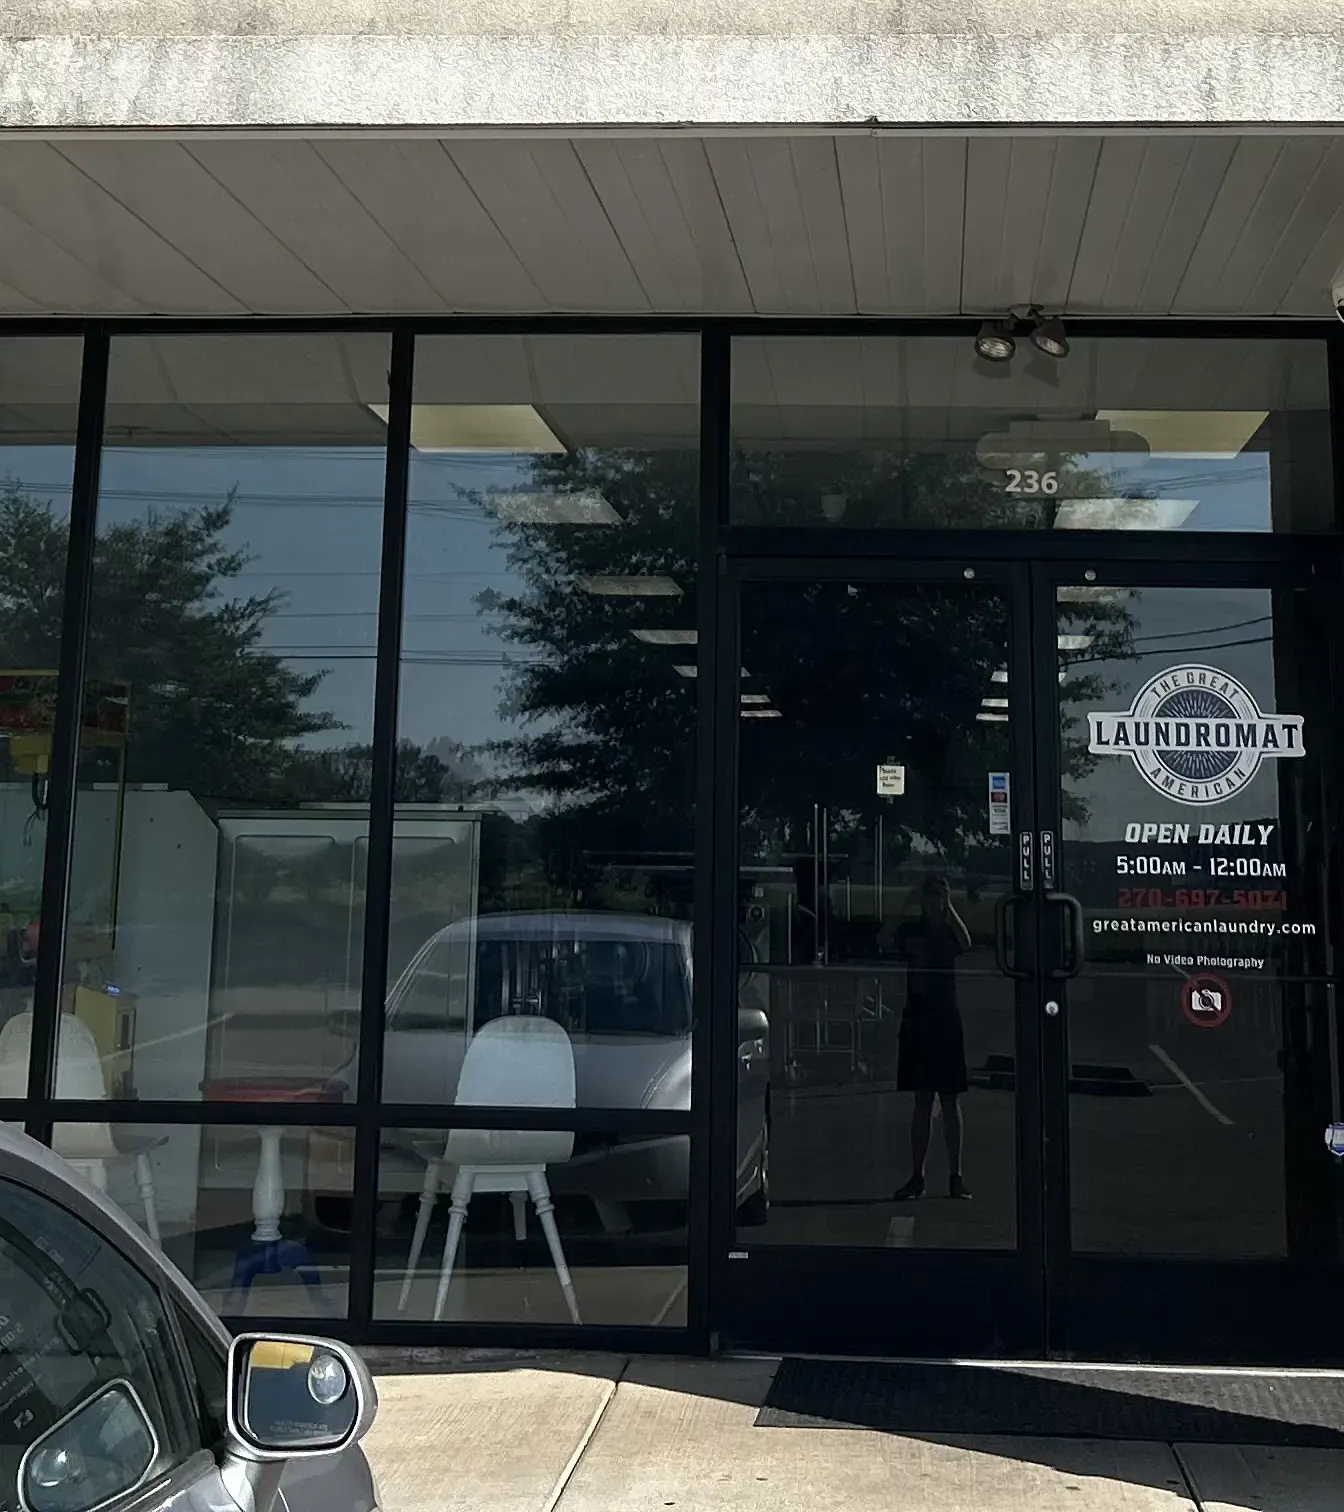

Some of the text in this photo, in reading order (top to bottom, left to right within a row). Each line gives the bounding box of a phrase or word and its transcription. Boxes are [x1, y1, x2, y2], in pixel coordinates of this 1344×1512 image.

[1004, 469, 1059, 495] 236
[1151, 671, 1240, 700] THE GREAT
[1096, 720, 1298, 749] LAUNDROMAT
[1149, 767, 1246, 799] AMERICAN
[1124, 822, 1275, 846] OPEN DAILY
[1043, 834, 1051, 880] PULL
[1116, 856, 1186, 876] 5:00AM
[1209, 857, 1287, 877] 12:00AM
[1092, 918, 1317, 936] greatamericanlaundry.com
[1146, 954, 1265, 969] No Video Photography
